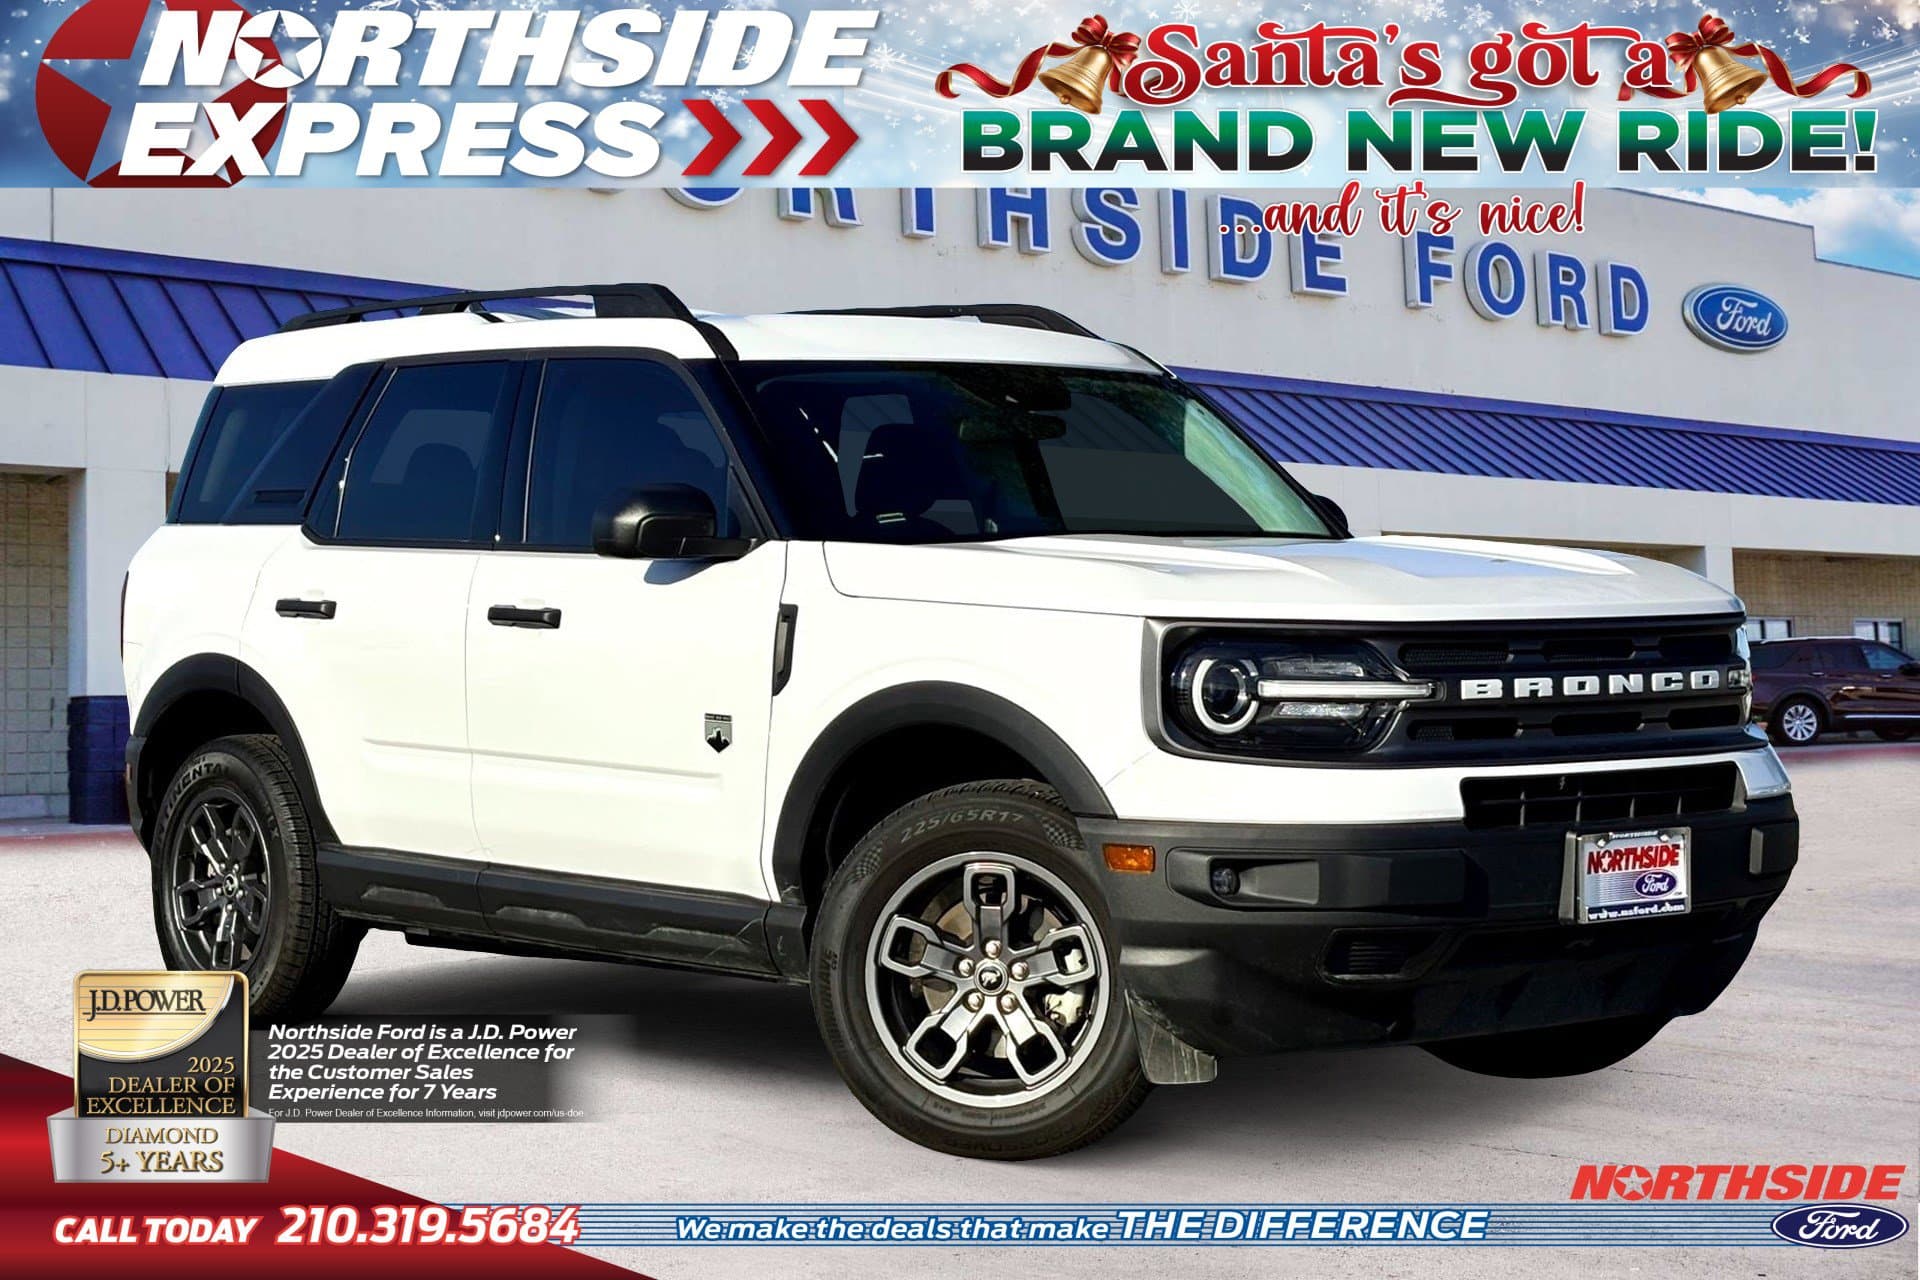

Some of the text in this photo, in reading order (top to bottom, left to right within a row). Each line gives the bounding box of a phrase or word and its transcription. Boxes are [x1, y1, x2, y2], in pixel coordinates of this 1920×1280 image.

[1405, 230, 1650, 336] FORD
[1715, 297, 1772, 338] Ford
[1460, 670, 1720, 700] BRONCO
[900, 808, 1025, 844] 225/65R17
[1587, 844, 1681, 875] NORTHSIDE
[1641, 873, 1670, 893] Ford
